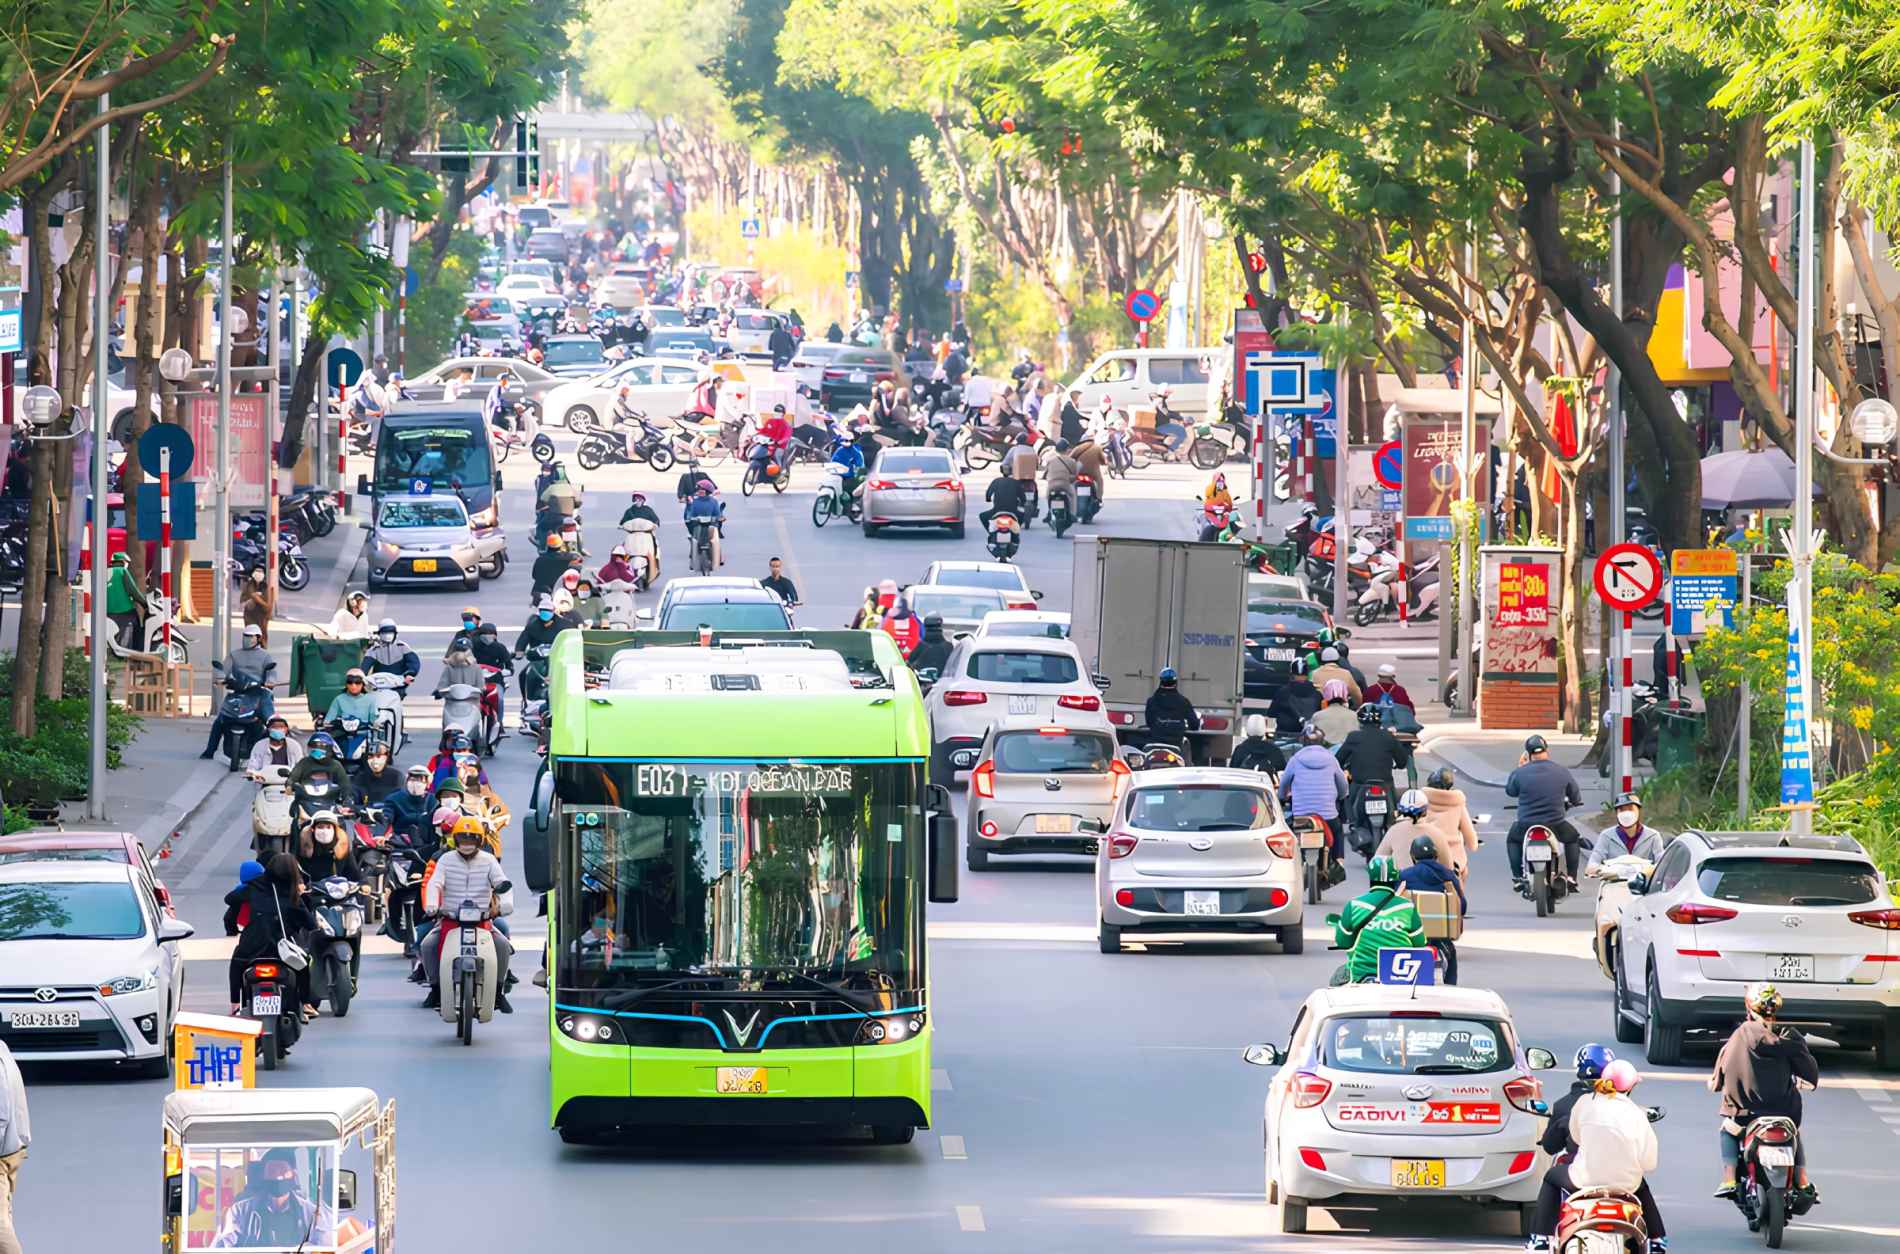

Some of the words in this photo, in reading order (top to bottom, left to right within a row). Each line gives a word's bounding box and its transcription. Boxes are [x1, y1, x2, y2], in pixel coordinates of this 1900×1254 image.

[637, 765, 674, 795] E03
[1390, 953, 1422, 981] G7
[1339, 1110, 1406, 1121] CADIVI
